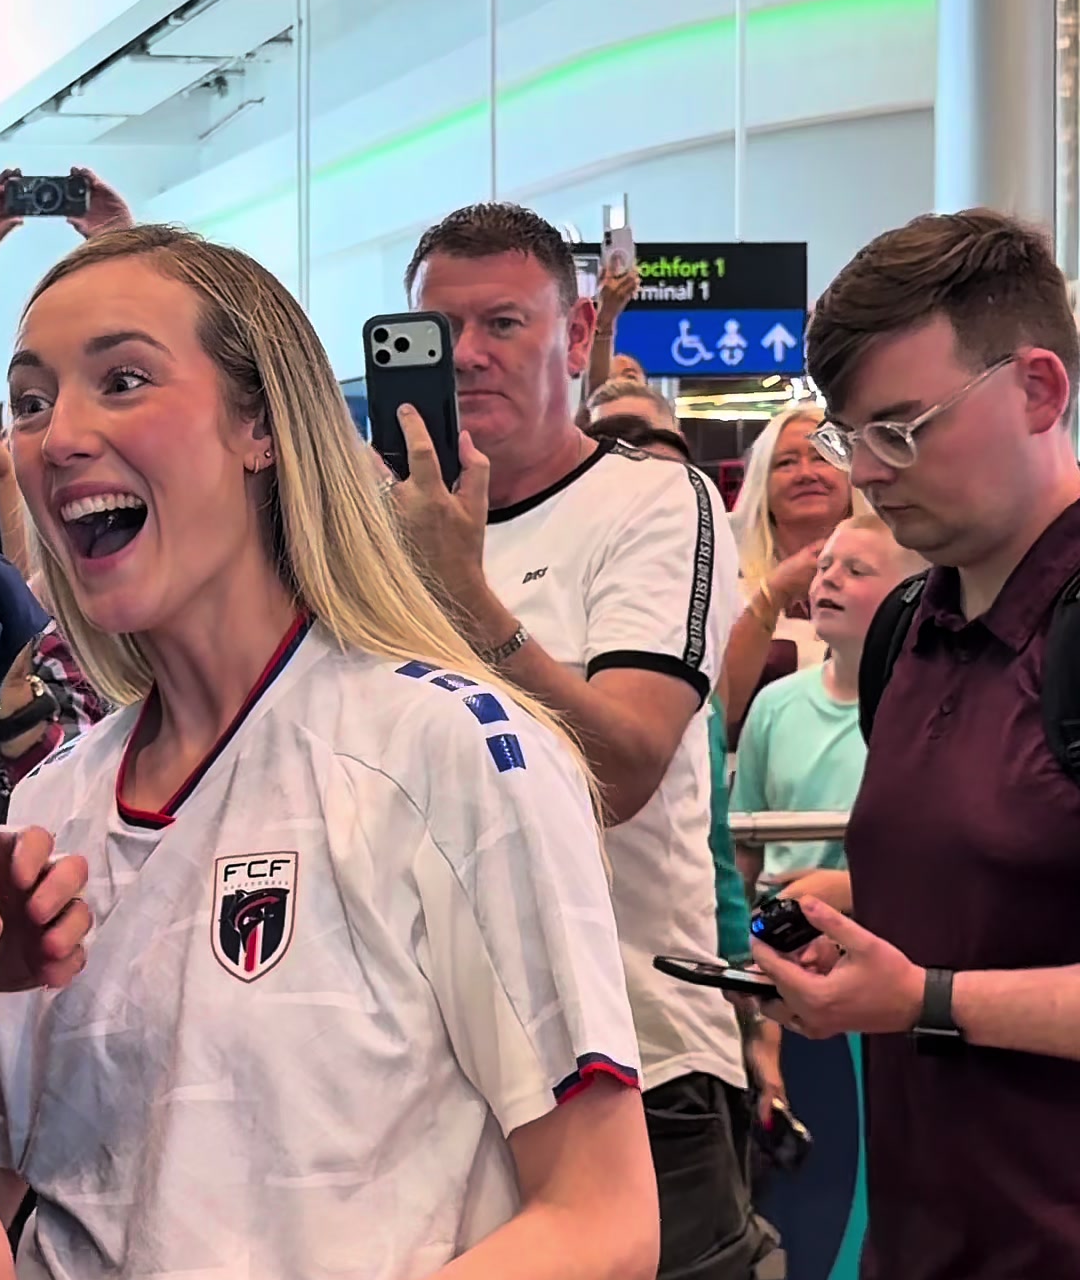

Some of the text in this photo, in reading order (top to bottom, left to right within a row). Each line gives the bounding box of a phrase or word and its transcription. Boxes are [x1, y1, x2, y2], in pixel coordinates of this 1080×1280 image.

[635, 256, 725, 277] ochfort 1
[631, 280, 710, 301] rminal 1
[223, 859, 291, 882] FCF
